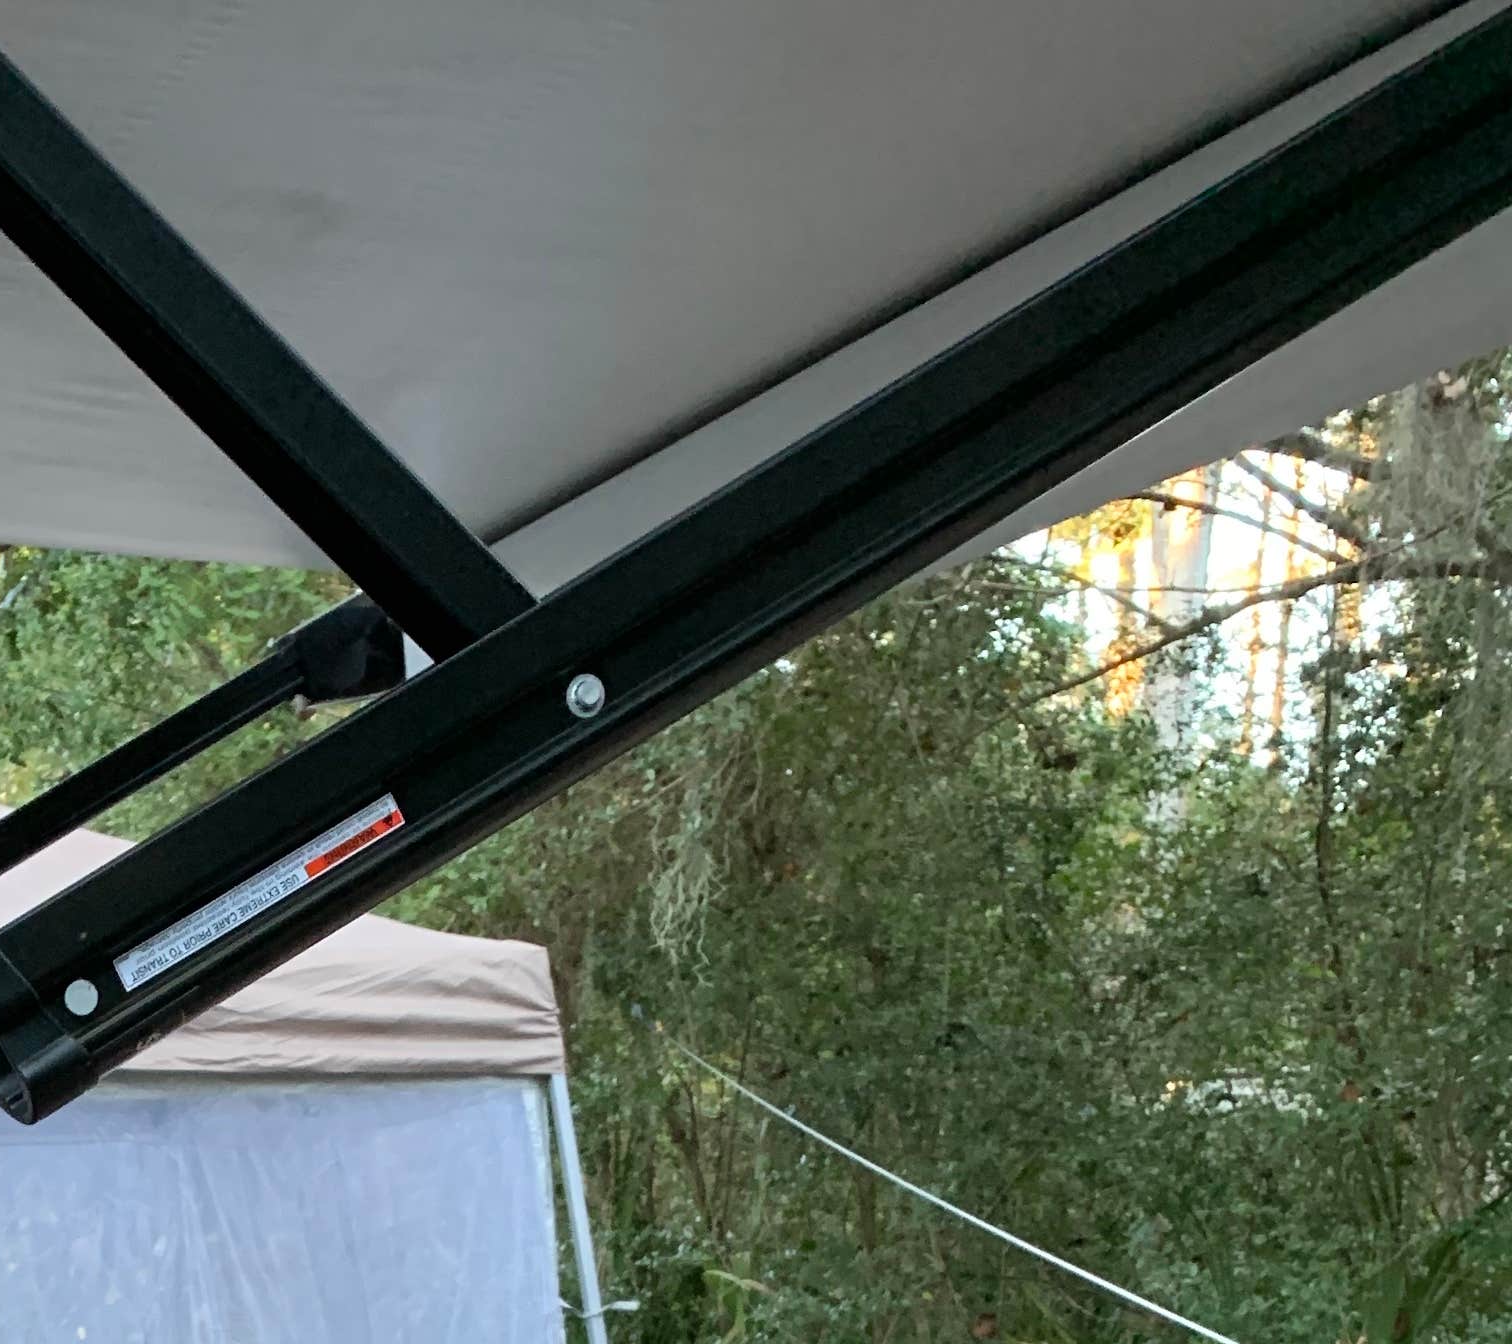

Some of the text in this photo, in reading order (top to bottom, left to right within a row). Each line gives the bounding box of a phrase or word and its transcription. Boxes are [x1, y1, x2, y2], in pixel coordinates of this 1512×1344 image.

[128, 873, 301, 982] USE EXTREME CARE PRIOR TO TRANSIT
